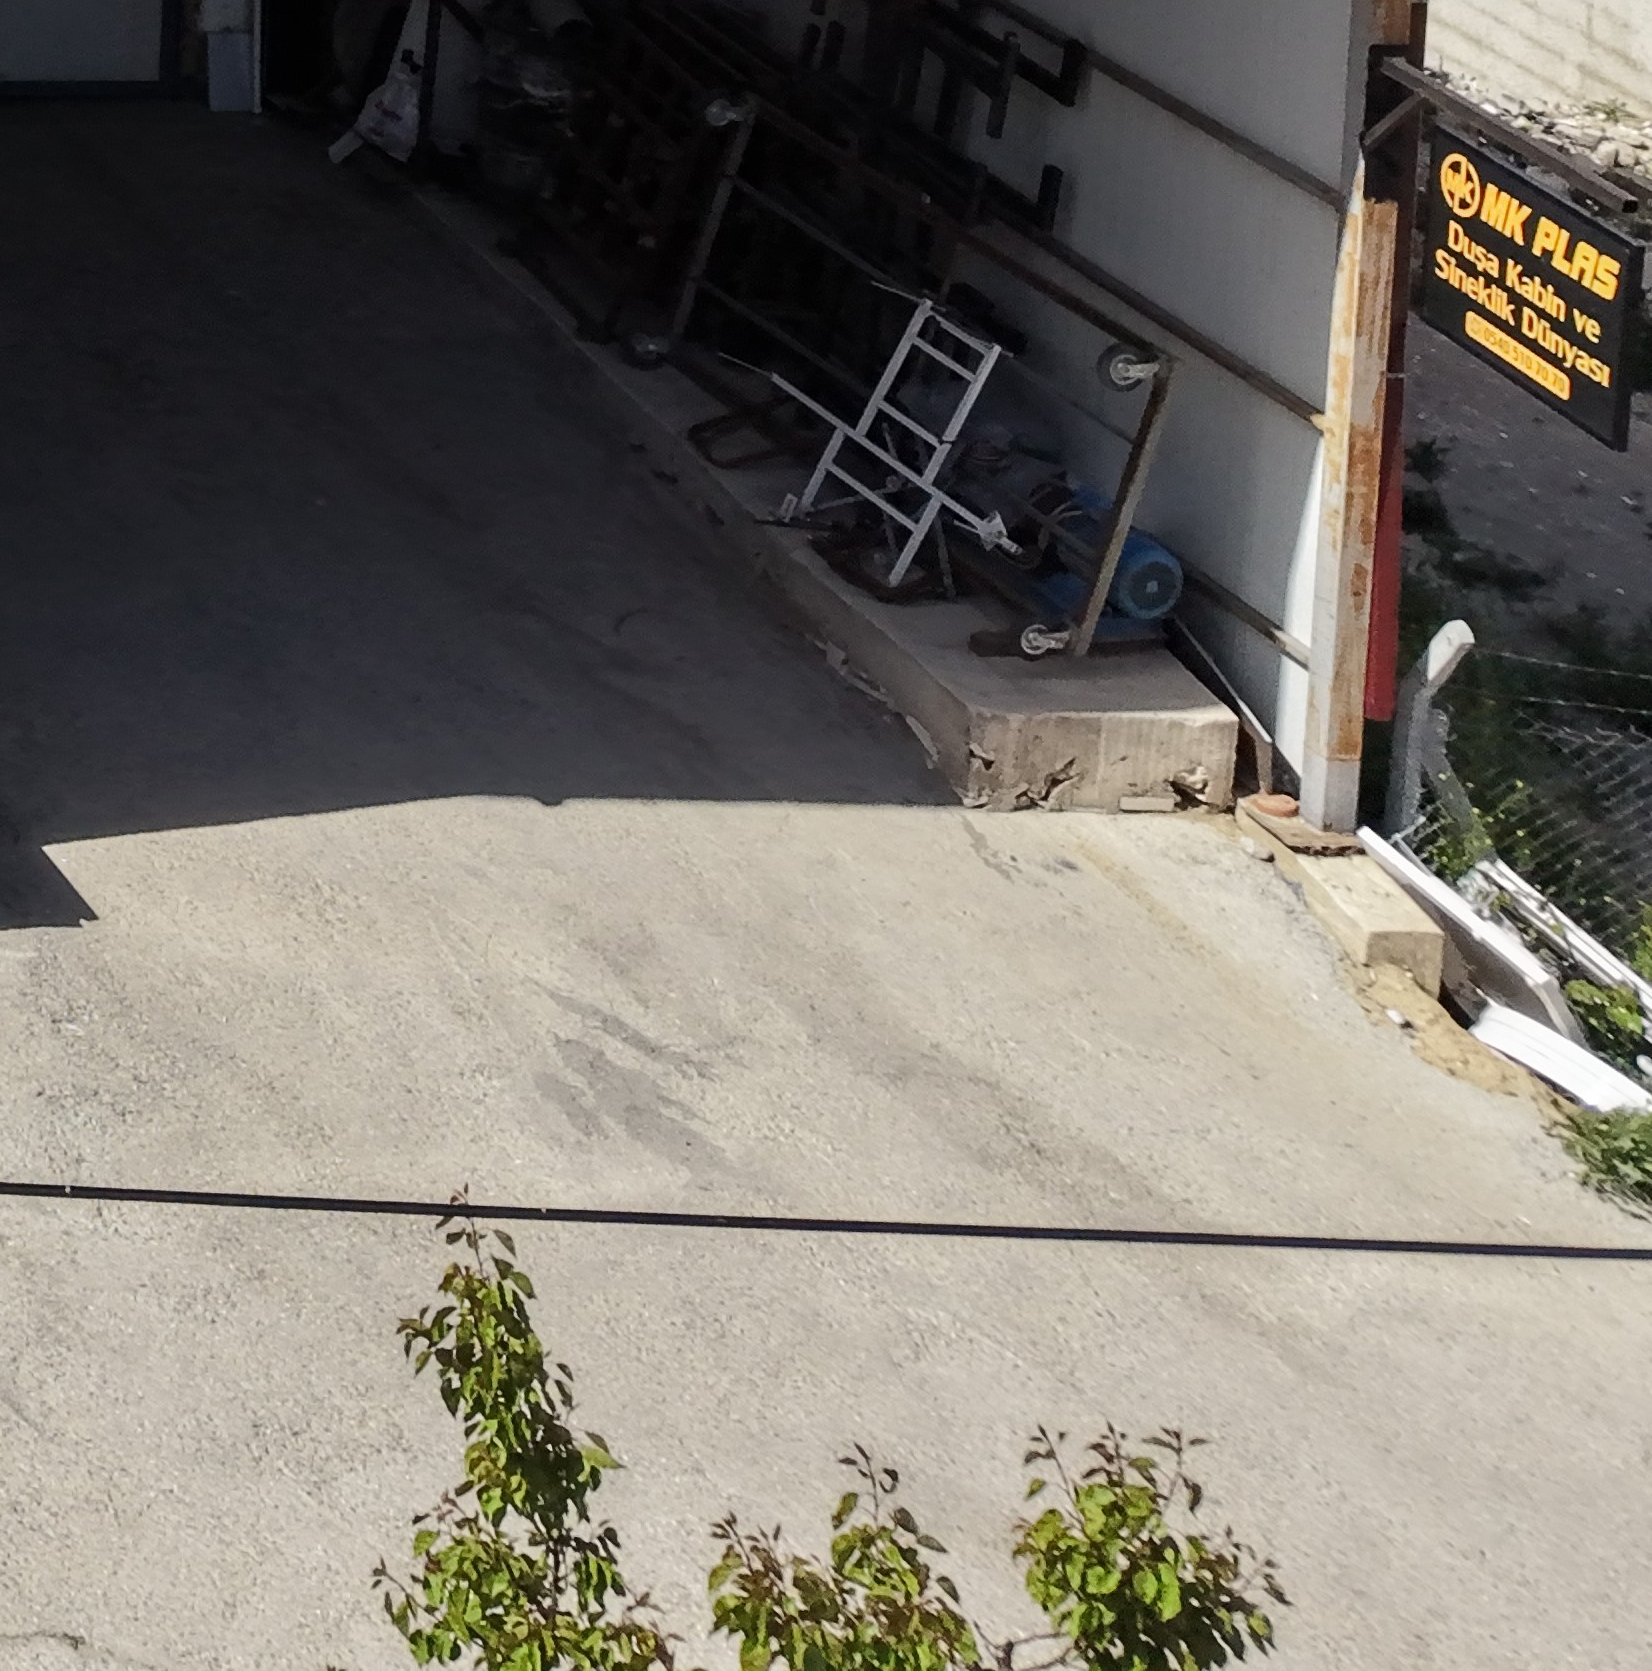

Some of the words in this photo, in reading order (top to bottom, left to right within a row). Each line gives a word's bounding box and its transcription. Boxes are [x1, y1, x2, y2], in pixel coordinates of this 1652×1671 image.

[1447, 219, 1500, 279] Duşa
[1505, 258, 1567, 323] Kabin
[1572, 307, 1602, 344] ve
[1479, 182, 1533, 246] MK
[1531, 216, 1622, 301] PLAS
[1434, 248, 1516, 327] Sineklik
[1520, 306, 1612, 388] Dünyası
